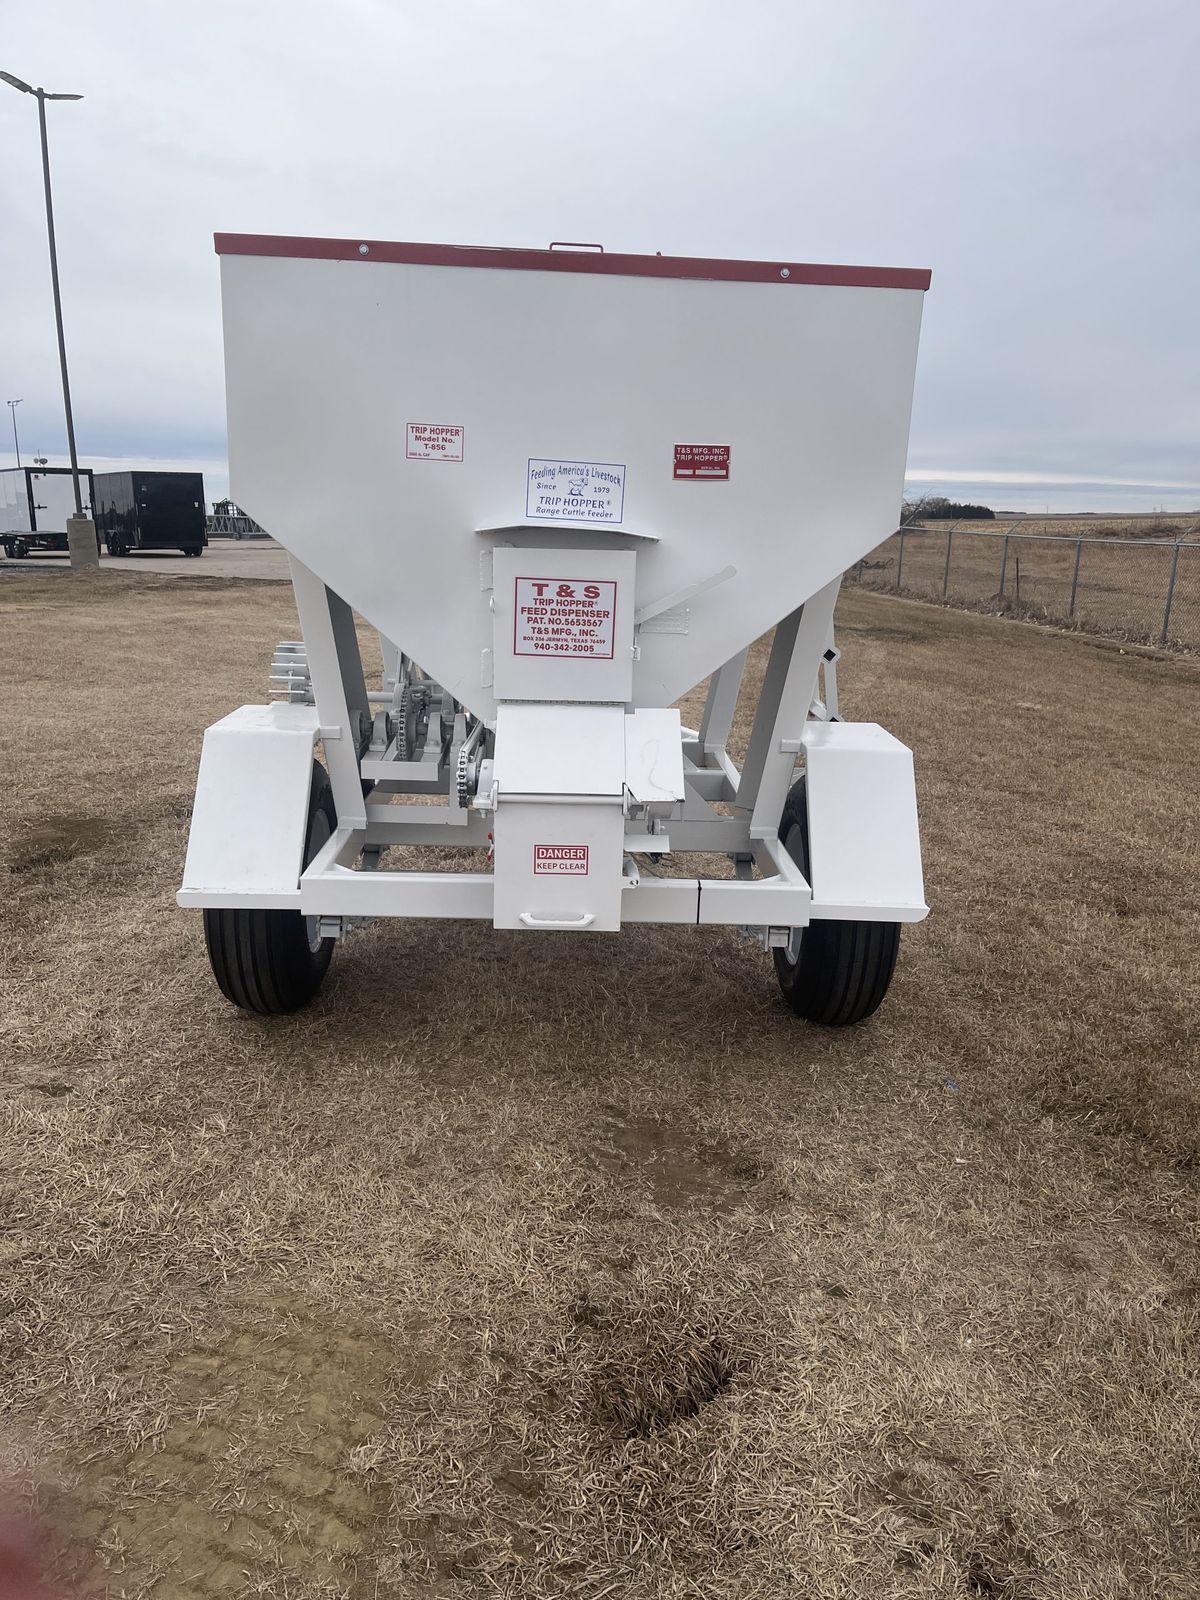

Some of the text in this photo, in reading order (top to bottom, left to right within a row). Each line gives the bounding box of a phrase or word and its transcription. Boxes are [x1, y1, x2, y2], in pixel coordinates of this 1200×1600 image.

[410, 426, 427, 434] TRIP
[531, 465, 621, 487] Feeding America's Livestock
[536, 482, 556, 490] Since
[539, 496, 561, 506] TRIP
[536, 506, 613, 518] Range Cattle Feeder
[532, 583, 600, 599] T & S
[533, 598, 554, 606] TRIP
[521, 607, 610, 618] FEED DISPENSER
[531, 627, 549, 635] T&S
[534, 643, 594, 652] 940-342-2005
[539, 848, 584, 858] DANGER
